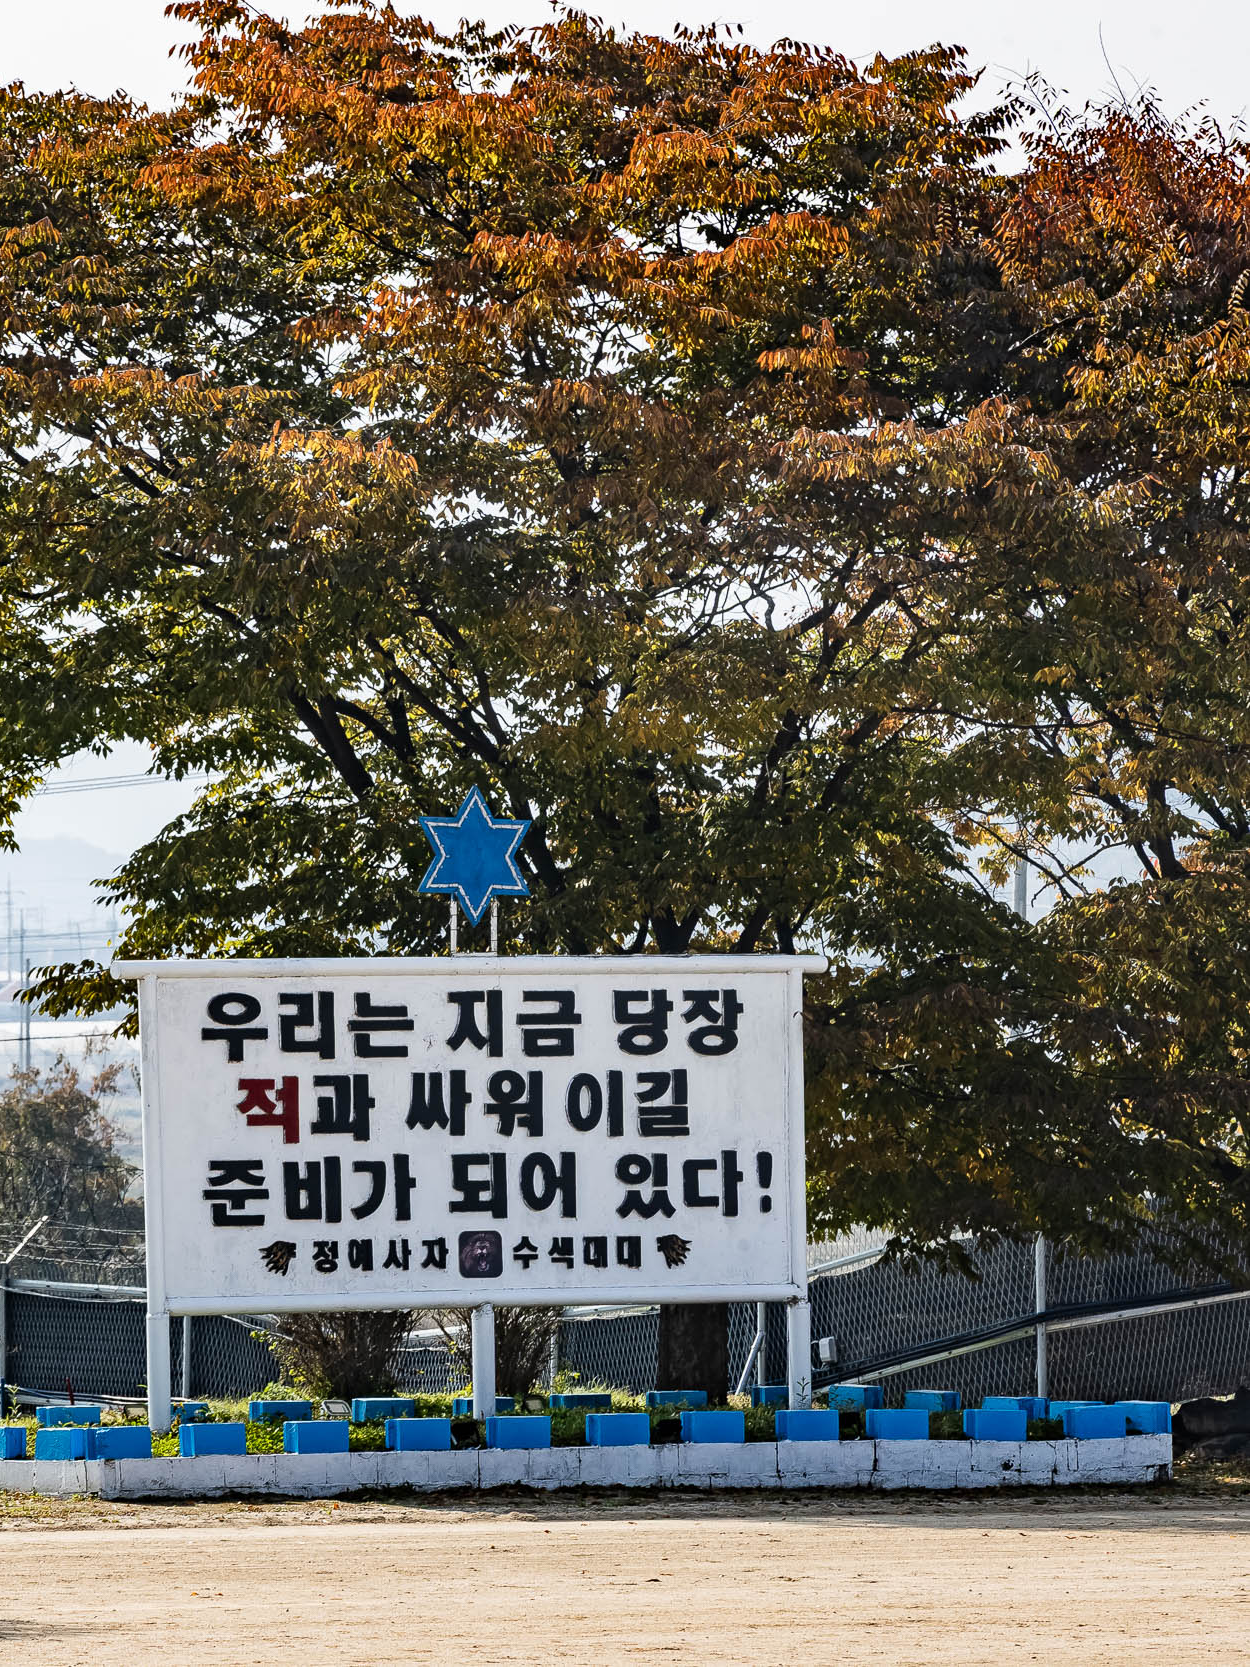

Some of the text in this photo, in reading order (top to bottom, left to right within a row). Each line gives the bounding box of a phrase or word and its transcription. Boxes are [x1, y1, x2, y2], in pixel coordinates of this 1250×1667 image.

[202, 988, 744, 1063] 우리는 지금 당장
[236, 1068, 690, 1144] 적과 싸워 이길
[203, 1149, 773, 1227] 준비가 되어 있다!
[311, 1235, 642, 1273] 정예사자 수색대대
